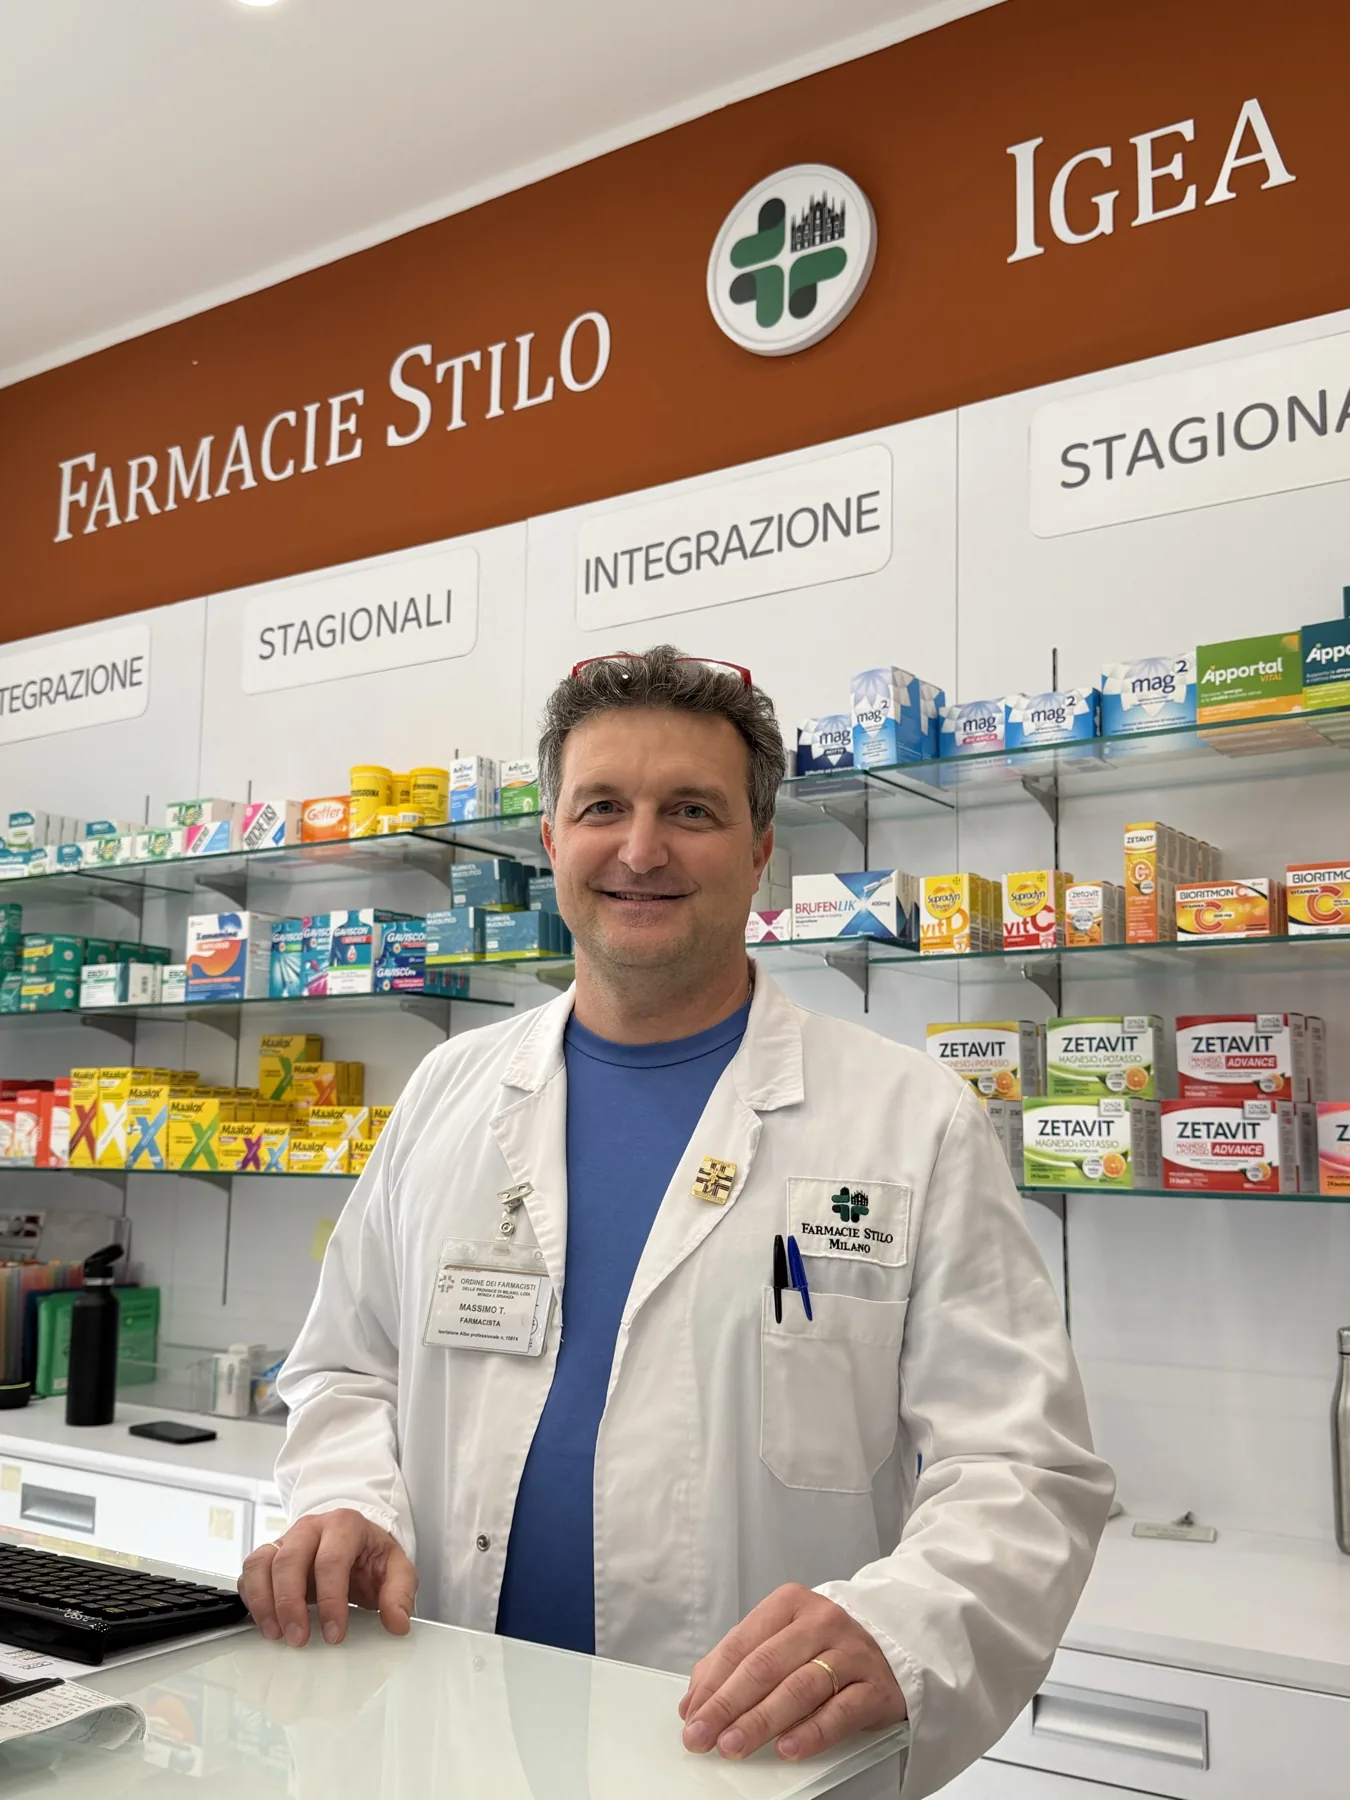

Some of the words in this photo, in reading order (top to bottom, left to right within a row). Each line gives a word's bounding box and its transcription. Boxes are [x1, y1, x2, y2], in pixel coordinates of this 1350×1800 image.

[1006, 98, 1296, 264] IGEA
[54, 388, 365, 543] FARMACIE
[386, 311, 612, 448] STILO
[584, 490, 881, 595] INTEGRAZIONE
[258, 589, 452, 661] STAGIONALI
[1200, 657, 1283, 685] Apportal
[1260, 673, 1283, 682] VITAL
[1131, 674, 1176, 694] mag
[857, 710, 882, 723] mag
[1031, 707, 1066, 723] mag
[963, 715, 997, 732] mag
[820, 730, 852, 746] mag
[306, 804, 342, 821] Geffer
[1126, 835, 1154, 844] ZETAVIT
[927, 892, 961, 903] Supradyn
[1011, 890, 1046, 902] Supradyn
[1179, 888, 1234, 900] BIORITMON
[334, 926, 369, 937] GAVISCON
[262, 1037, 293, 1048] Maalox
[1061, 1036, 1138, 1052] ZETAVIT
[1191, 1035, 1273, 1053] ZETAVIT
[939, 1041, 1006, 1057] ZETAVIT
[1103, 1055, 1142, 1063] POTASSIO
[1227, 1057, 1275, 1068] ADVANCE
[101, 1070, 130, 1079] Maalox
[129, 1087, 162, 1099] Maalox
[171, 1101, 206, 1113] Maalox
[311, 1108, 345, 1119] Maalox
[221, 1124, 256, 1136] Maalox
[263, 1127, 288, 1136] Maalox
[1038, 1120, 1114, 1136] ZETAVIT
[1176, 1122, 1260, 1139] ZETAVIT
[292, 1141, 326, 1152] Maalox
[1035, 1140, 1073, 1148] MAGNESIO
[1080, 1139, 1119, 1148] POTASSIO
[1212, 1145, 1263, 1155] ADVANCE
[801, 1222, 860, 1238] FARMACIE
[864, 1228, 894, 1244] STILO
[829, 1238, 871, 1254] MILANO
[460, 1278, 485, 1286] ORDINE
[497, 1282, 536, 1291] FARMACISTI
[459, 1303, 498, 1314] MASSIMO
[500, 1306, 506, 1314] T.
[460, 1317, 501, 1327] FARMACISTA
[470, 1332, 500, 1340] professionale
